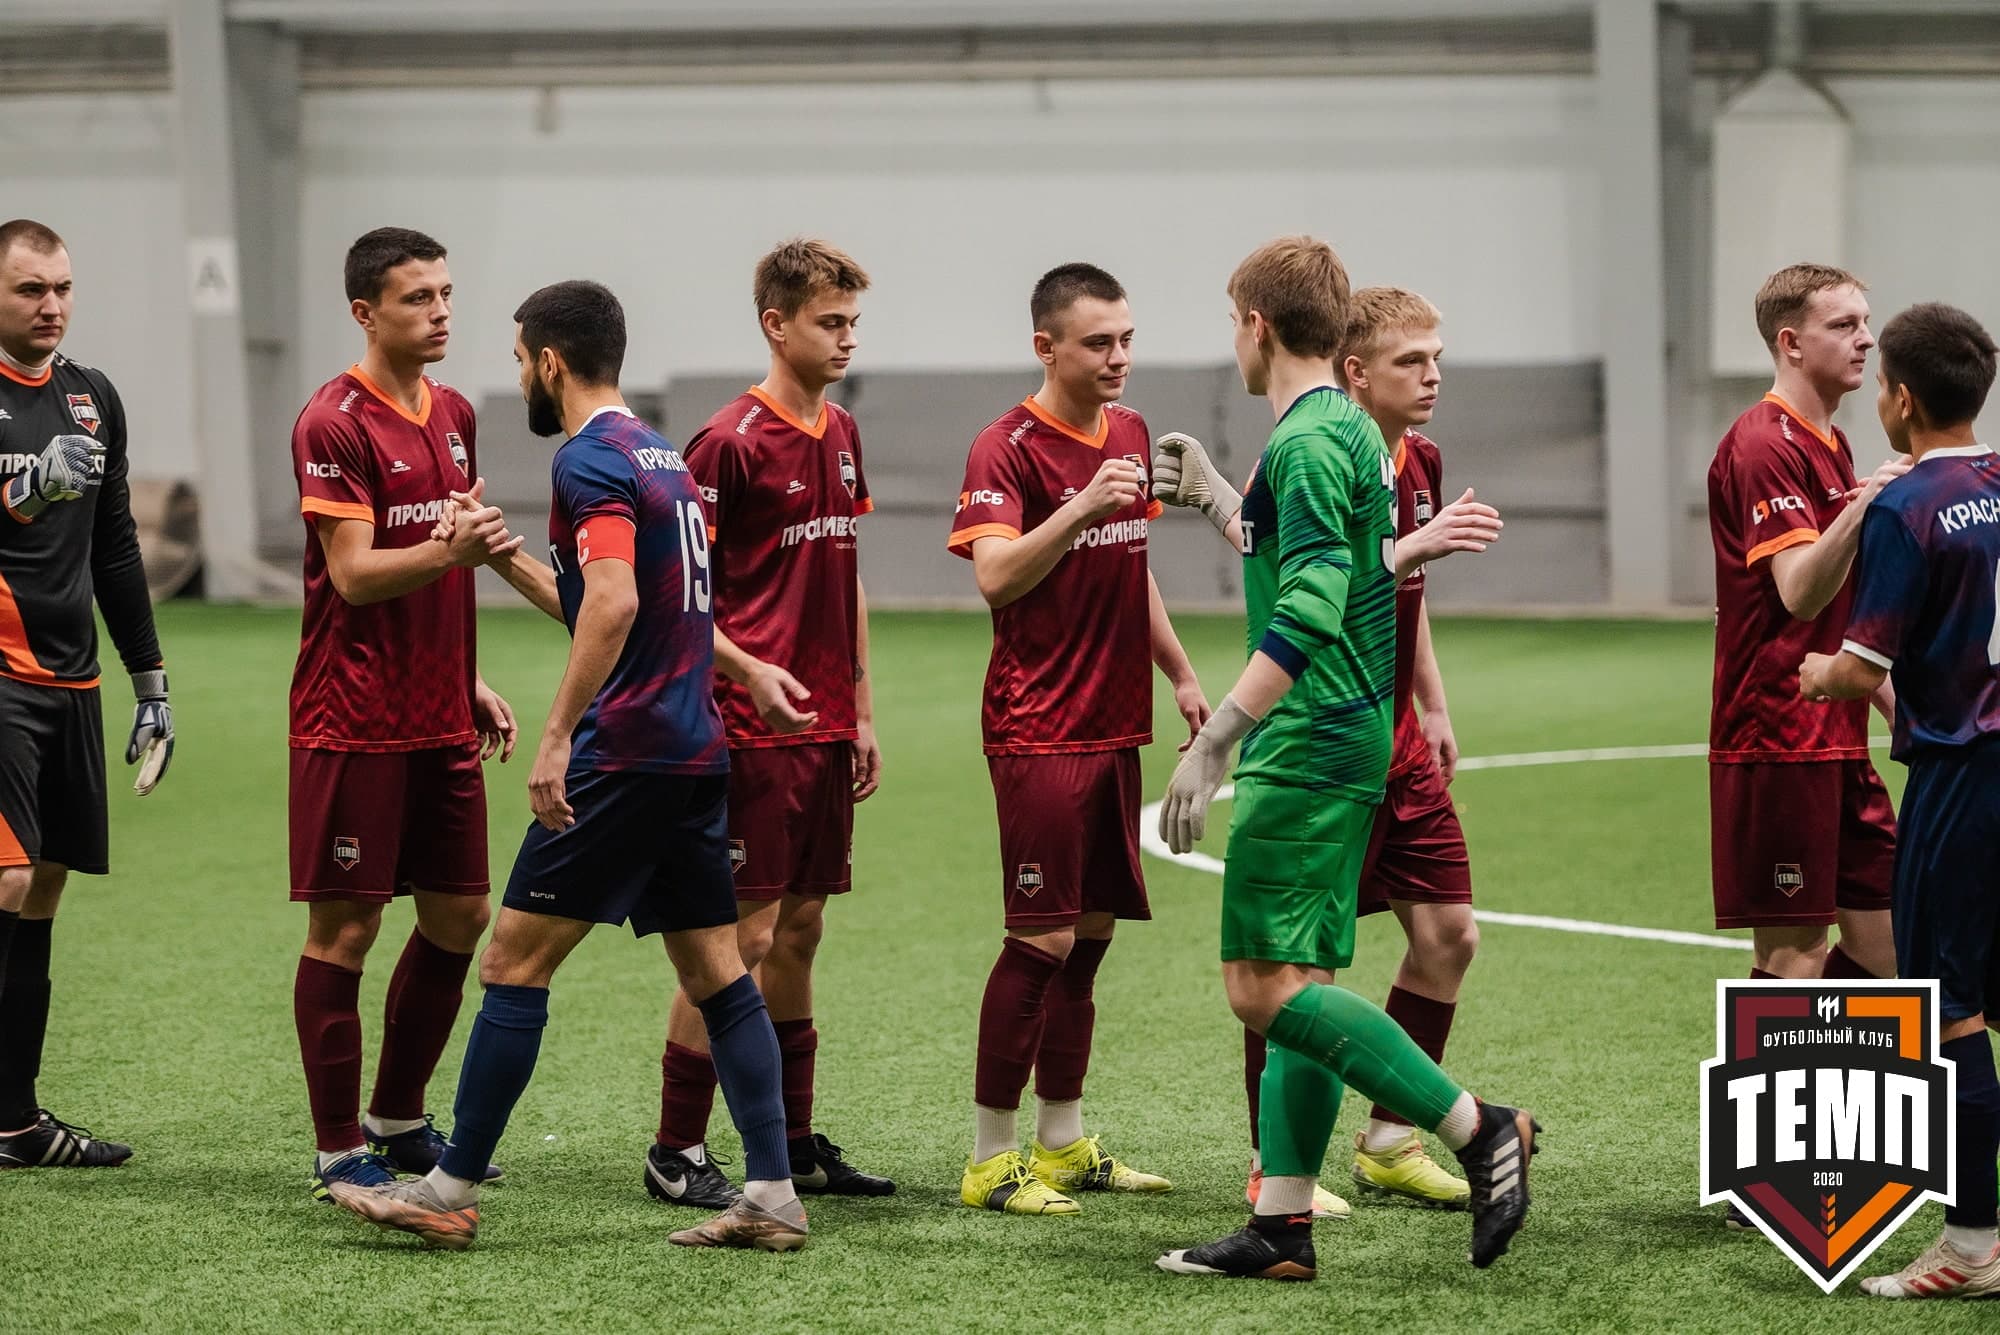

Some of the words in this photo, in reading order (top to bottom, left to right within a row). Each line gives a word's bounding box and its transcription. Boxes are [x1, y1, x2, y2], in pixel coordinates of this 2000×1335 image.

[306, 461, 342, 478] ПСБ
[970, 489, 1005, 506] ПСБ
[676, 500, 712, 614] 19
